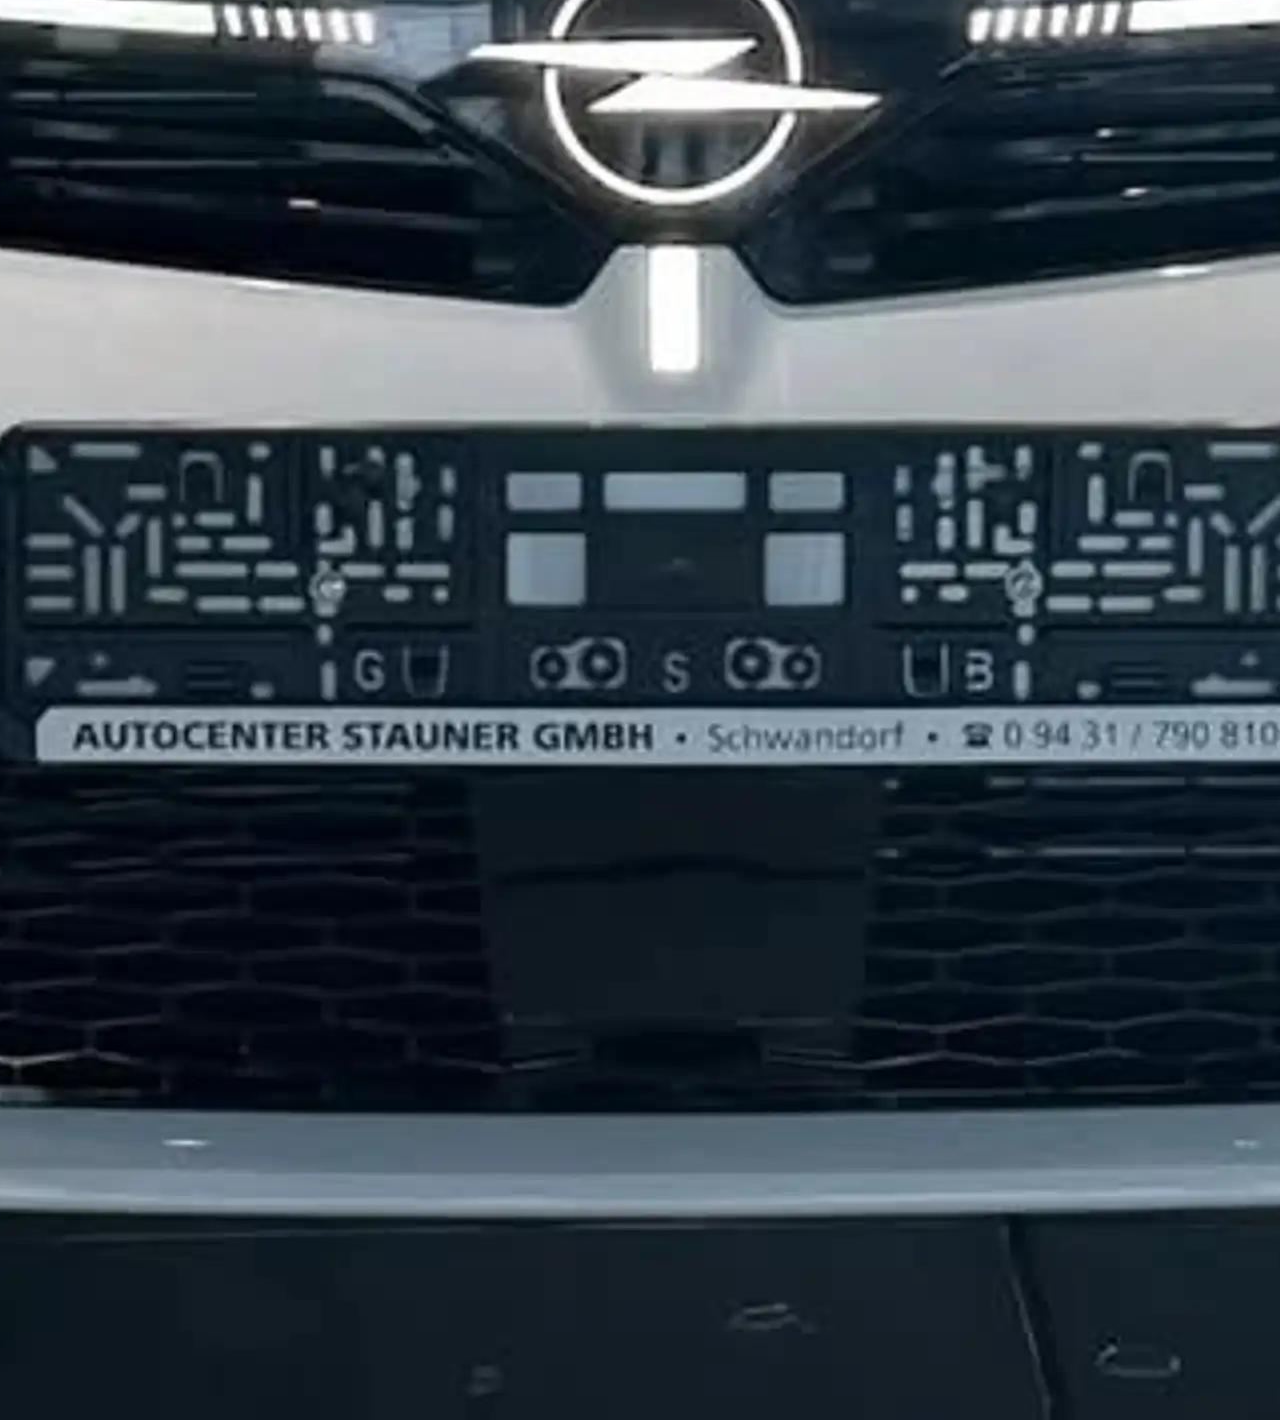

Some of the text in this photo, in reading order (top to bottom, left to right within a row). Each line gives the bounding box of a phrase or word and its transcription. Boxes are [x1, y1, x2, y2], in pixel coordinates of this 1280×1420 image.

[72, 720, 330, 752] AUTOCENTER
[342, 720, 520, 752] STAUNER
[532, 721, 654, 752] GMBH
[707, 720, 904, 752] Schwandorf
[1152, 720, 1210, 748] 790
[1219, 720, 1280, 747] 810
